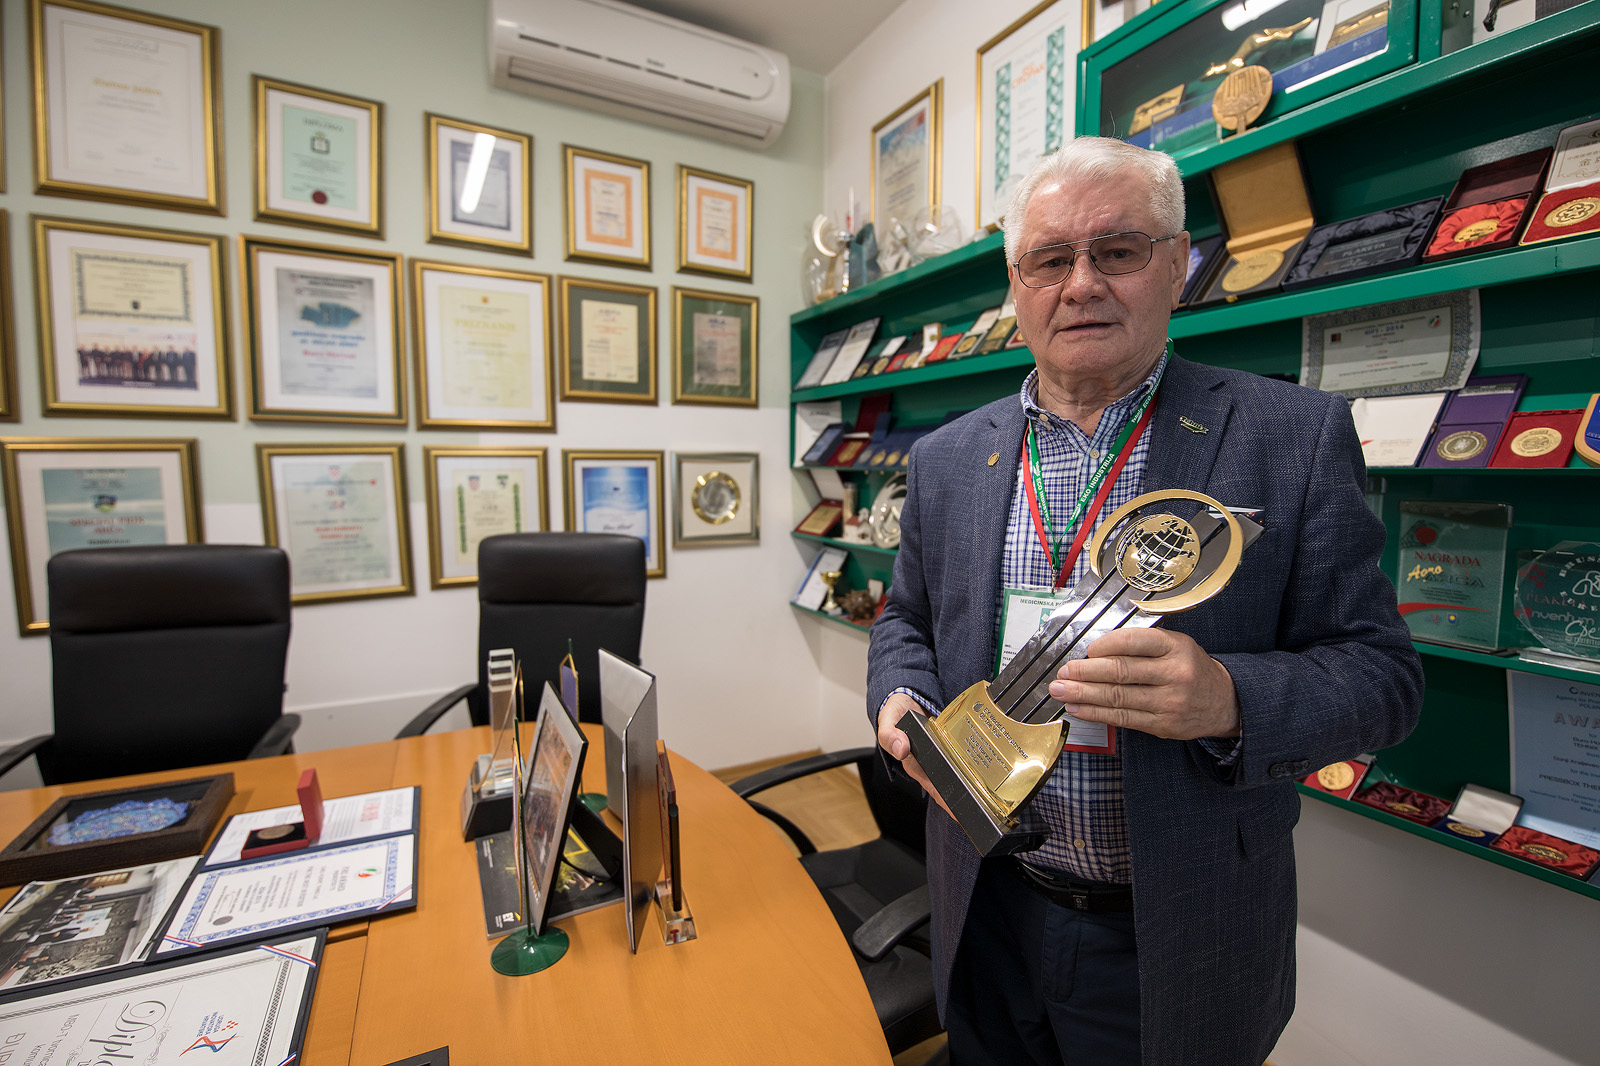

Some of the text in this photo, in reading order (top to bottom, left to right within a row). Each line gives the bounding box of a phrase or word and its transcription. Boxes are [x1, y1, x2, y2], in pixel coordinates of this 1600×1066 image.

[1080, 488, 1092, 503] EKO
[1088, 453, 1116, 489] INDUSTRIJA
[1414, 551, 1481, 567] NAGRADA
[1020, 598, 1054, 607] MEDICINSKA
